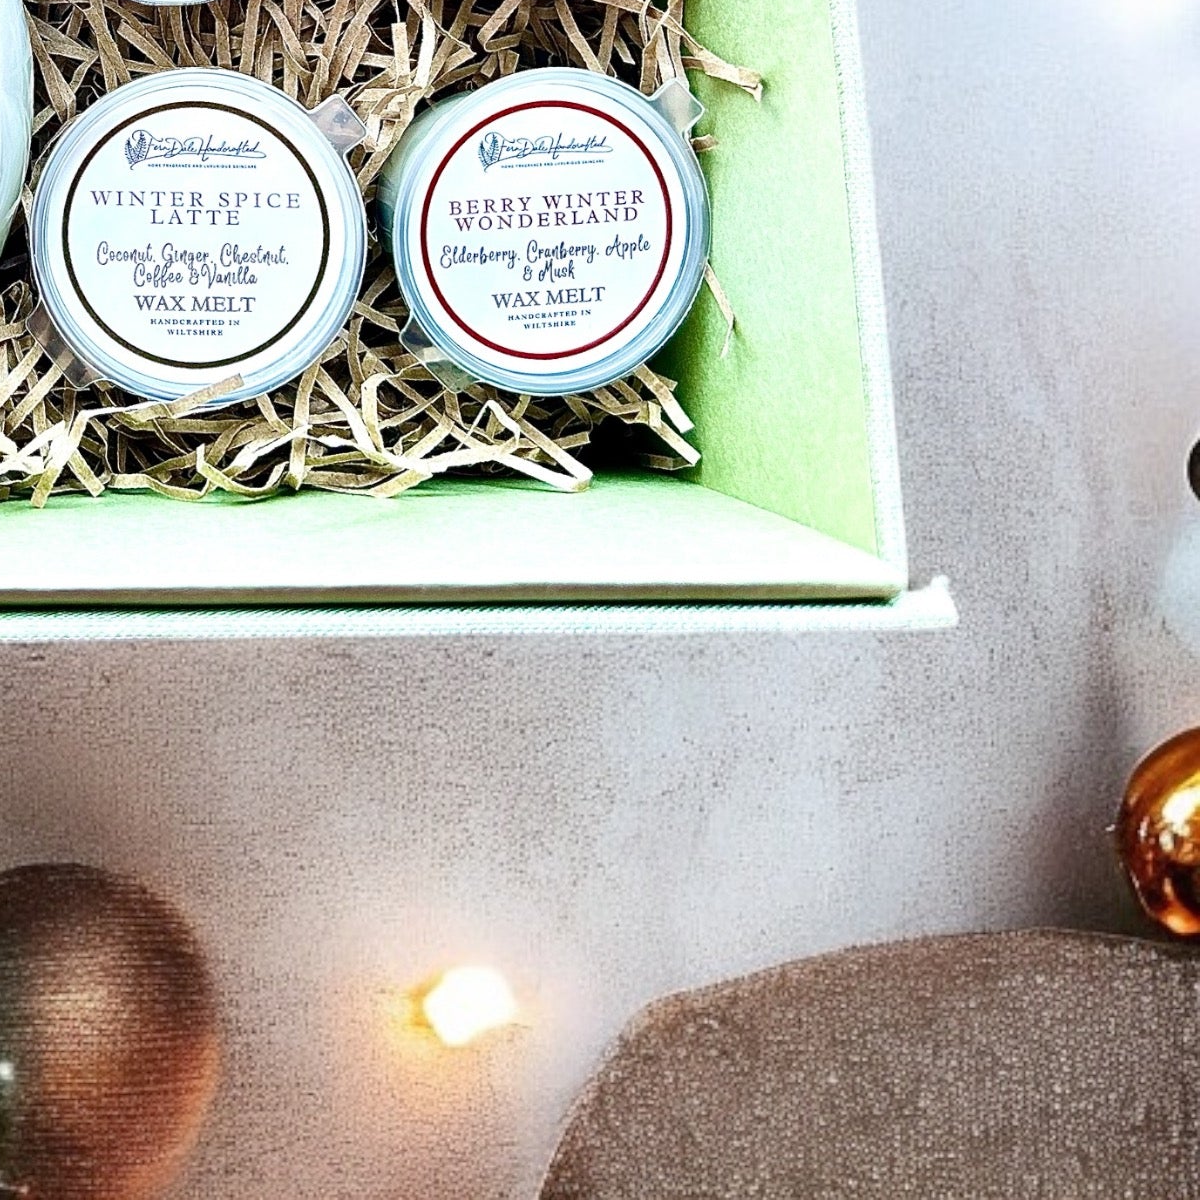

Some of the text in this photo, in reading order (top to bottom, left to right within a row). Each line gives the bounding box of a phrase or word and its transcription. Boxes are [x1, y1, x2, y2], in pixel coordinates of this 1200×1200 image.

[90, 190, 301, 209] WINTER SPICE
[449, 189, 646, 216] BERRY WINTER
[150, 209, 240, 226] LATTE
[455, 207, 638, 232] WONDERLAND
[605, 234, 650, 260] Apple
[133, 263, 258, 289] Coffee & Vanilla
[523, 258, 575, 283] & Musk
[133, 295, 256, 313] WAX MELT
[491, 287, 606, 309] WAX MELT
[150, 318, 225, 326] HANDCRAFTED
[508, 310, 577, 321] HANDCRAFTED
[167, 328, 224, 336] WILTSHIRE
[523, 321, 576, 330] WILTSHIRE
